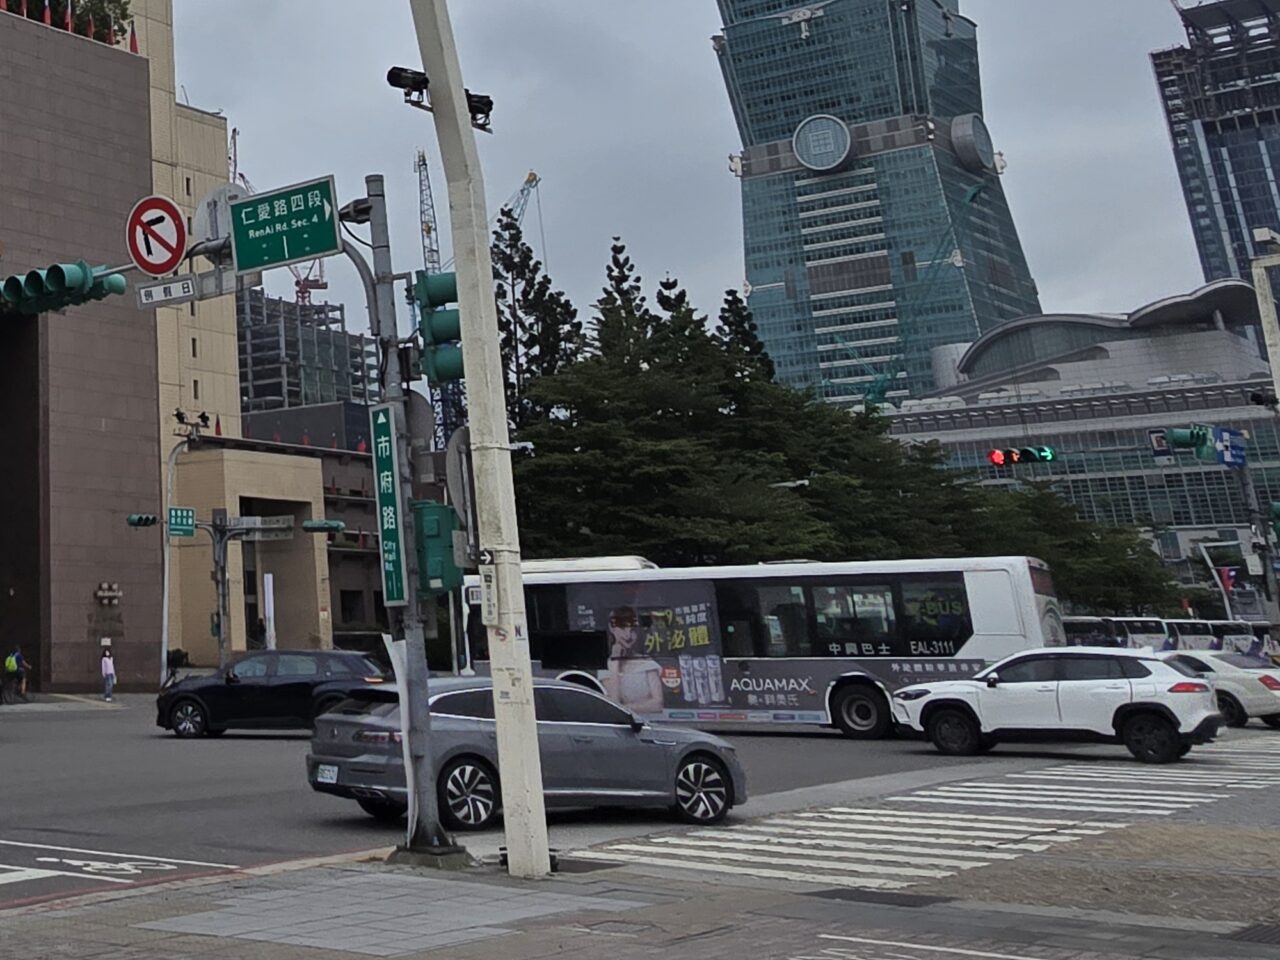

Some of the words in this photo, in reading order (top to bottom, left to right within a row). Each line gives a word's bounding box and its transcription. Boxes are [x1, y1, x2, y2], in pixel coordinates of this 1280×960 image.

[241, 190, 322, 225] 仁愛路四段
[248, 225, 274, 239] RenAi
[275, 221, 289, 233] Rd.
[291, 217, 310, 229] Sec.
[311, 213, 318, 223] 4
[143, 281, 191, 301] 例假日
[375, 434, 397, 530] 市府路
[644, 625, 711, 653] 外泌體
[910, 640, 955, 655] EAL-3111
[730, 678, 812, 692] AQUAMAX
